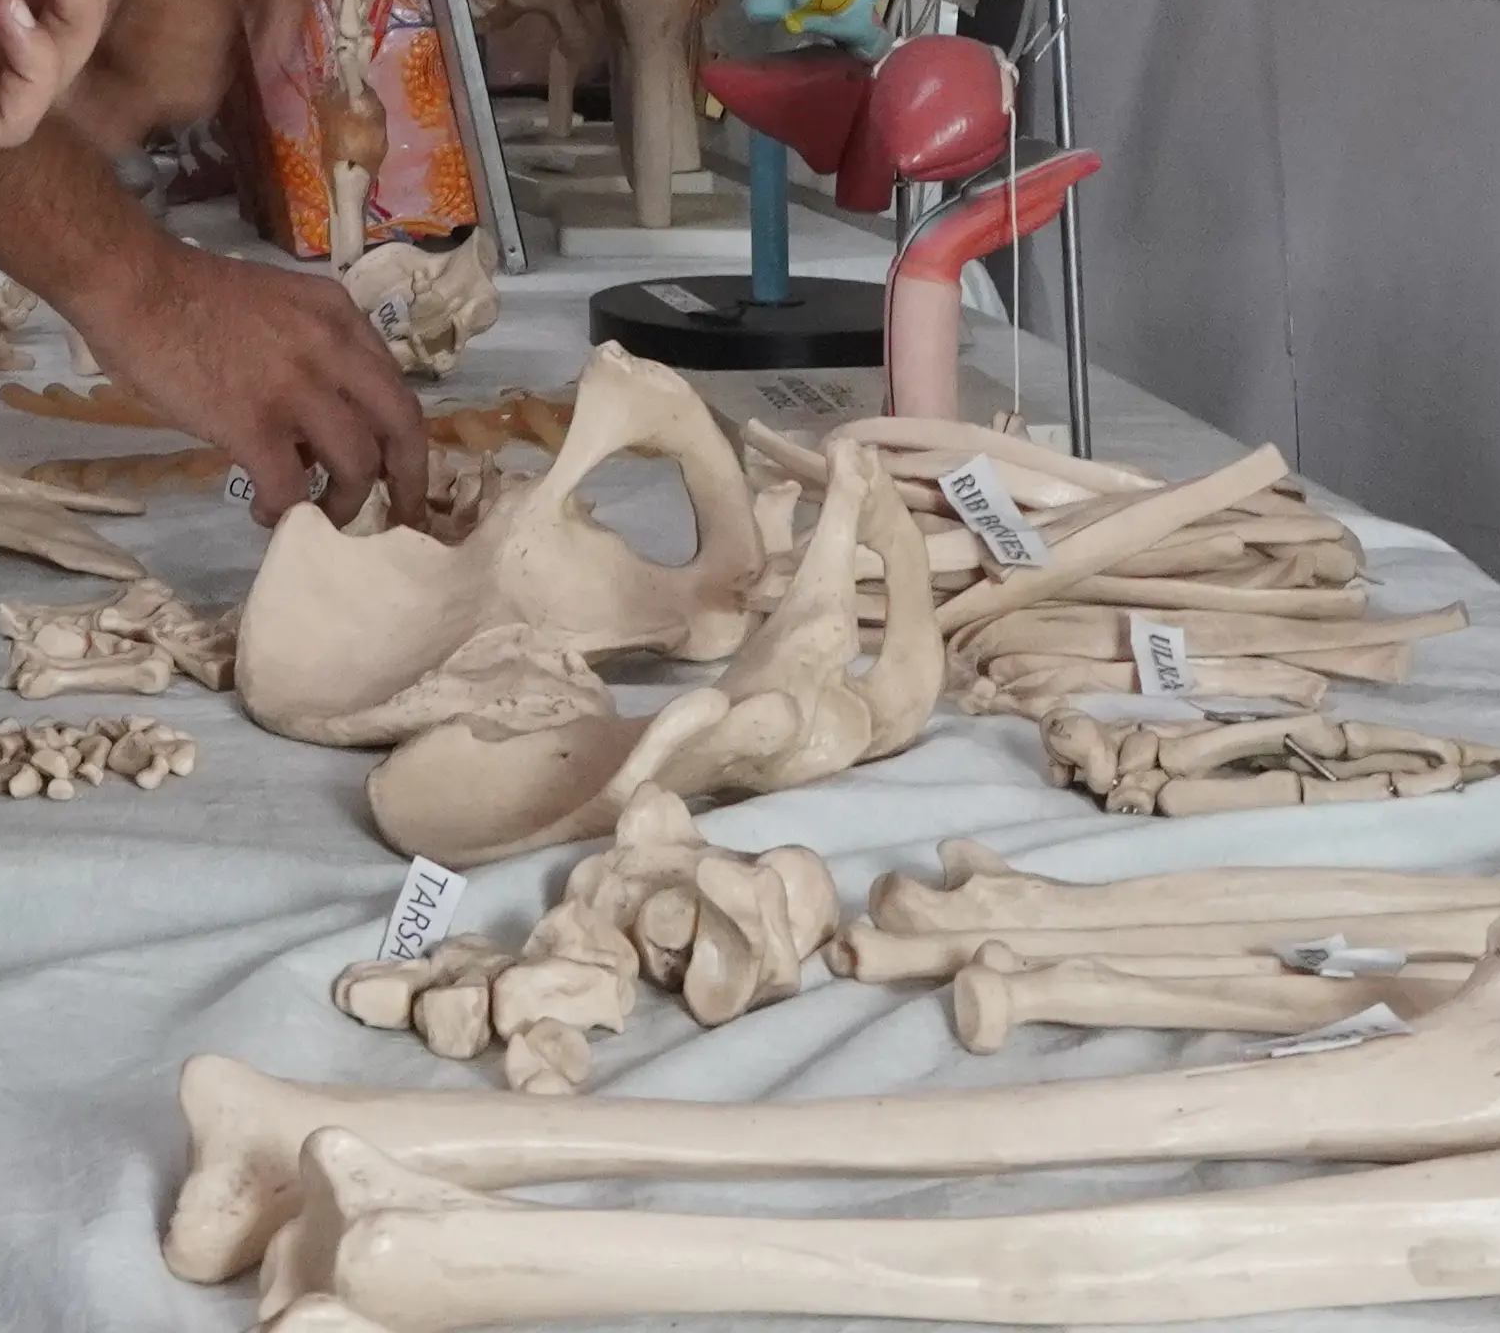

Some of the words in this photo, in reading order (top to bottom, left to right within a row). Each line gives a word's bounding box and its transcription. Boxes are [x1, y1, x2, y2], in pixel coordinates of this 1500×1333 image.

[950, 473, 990, 513] RIB
[975, 514, 1032, 561] BONES
[1148, 633, 1185, 691] ULNA
